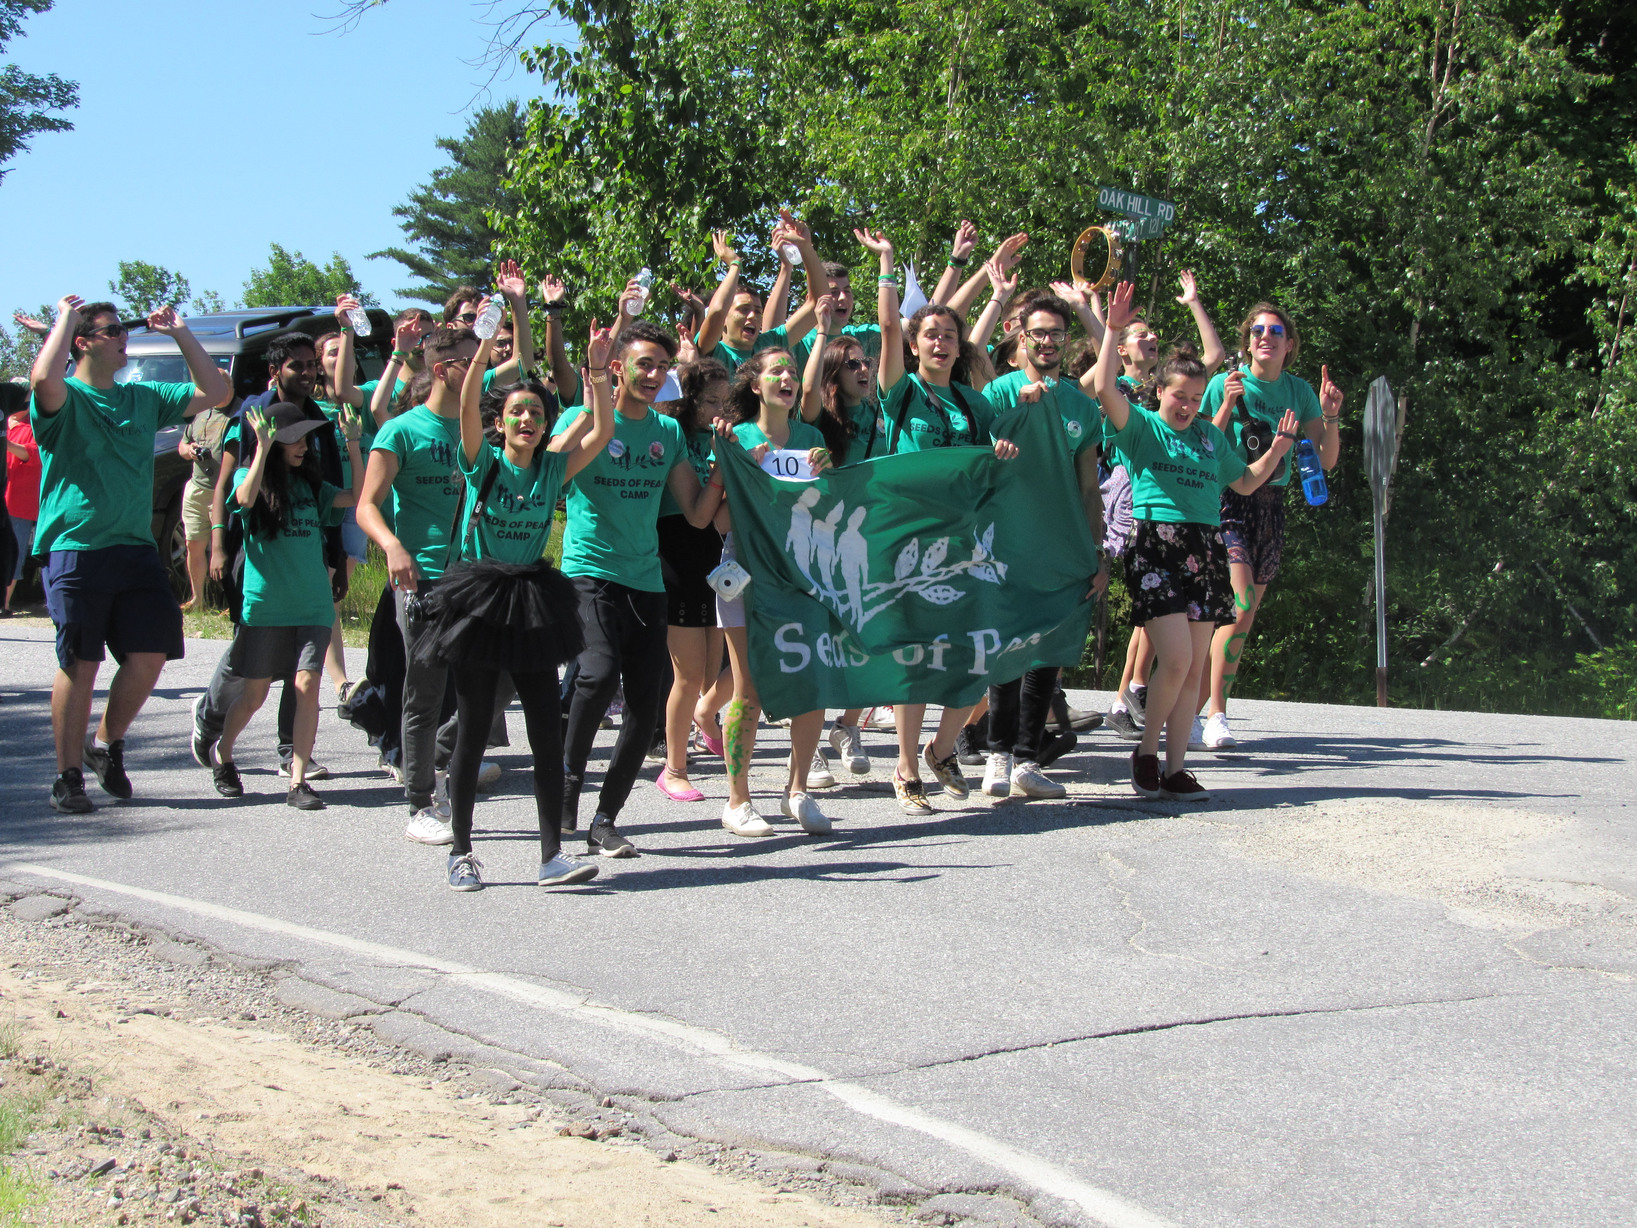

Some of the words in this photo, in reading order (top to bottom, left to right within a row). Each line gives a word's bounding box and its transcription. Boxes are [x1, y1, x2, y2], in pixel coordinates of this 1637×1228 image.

[1099, 189, 1125, 210] OAK
[1126, 195, 1152, 217] HILL
[1157, 202, 1175, 221] RD
[909, 423, 941, 435] SEEDS
[772, 456, 799, 476] 10
[1151, 461, 1184, 474] SEEDS
[415, 475, 450, 485] SEEDS
[593, 475, 626, 488] SEEDS
[627, 478, 642, 488] OF
[643, 479, 664, 488] PEA
[442, 486, 460, 496] CA
[620, 489, 650, 499] CAMP
[291, 518, 304, 528] OF
[508, 520, 523, 529] OF
[283, 529, 312, 539] CAMP
[496, 529, 531, 541] CAMP
[892, 633, 951, 672] of
